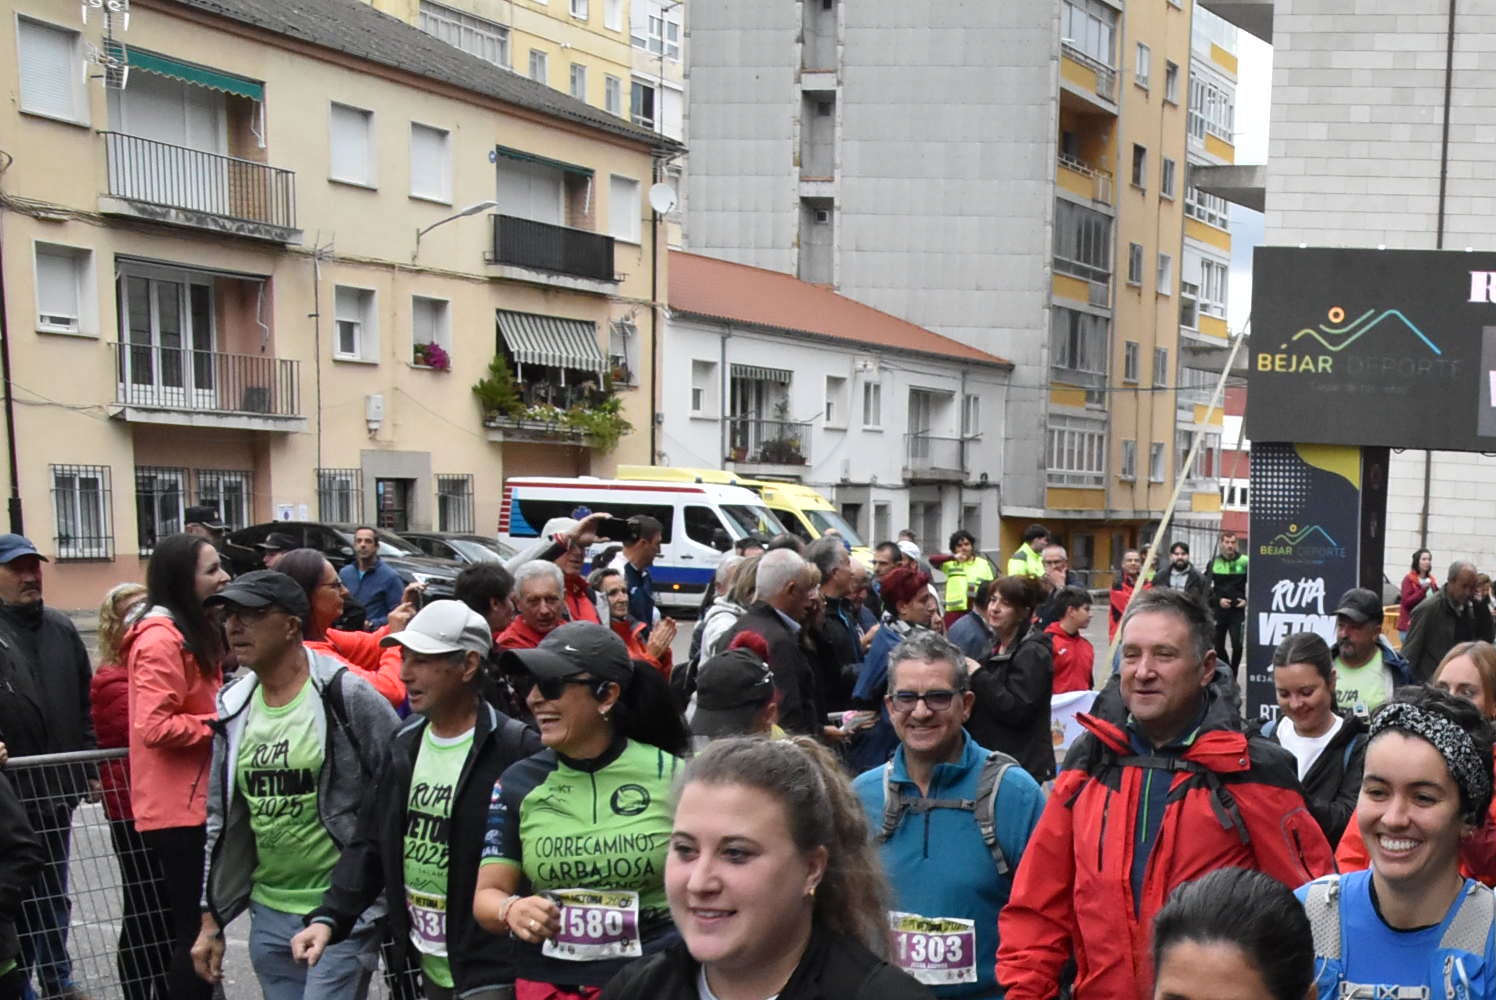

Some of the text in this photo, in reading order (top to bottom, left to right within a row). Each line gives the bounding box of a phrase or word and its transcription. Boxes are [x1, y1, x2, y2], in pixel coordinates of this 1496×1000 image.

[1256, 343, 1333, 374] BÉJAR
[1271, 576, 1327, 615] RUTA
[1259, 612, 1338, 646] VETON
[1260, 704, 1279, 722] BT
[252, 739, 289, 769] RUTA
[244, 768, 314, 797] VETONA
[256, 797, 303, 818] 2025
[410, 782, 452, 818] RUTA
[535, 833, 655, 858] CORRECAMINOS
[537, 857, 656, 882] CARBAJOSA
[559, 907, 623, 938] 1580
[898, 932, 963, 963] 1303
